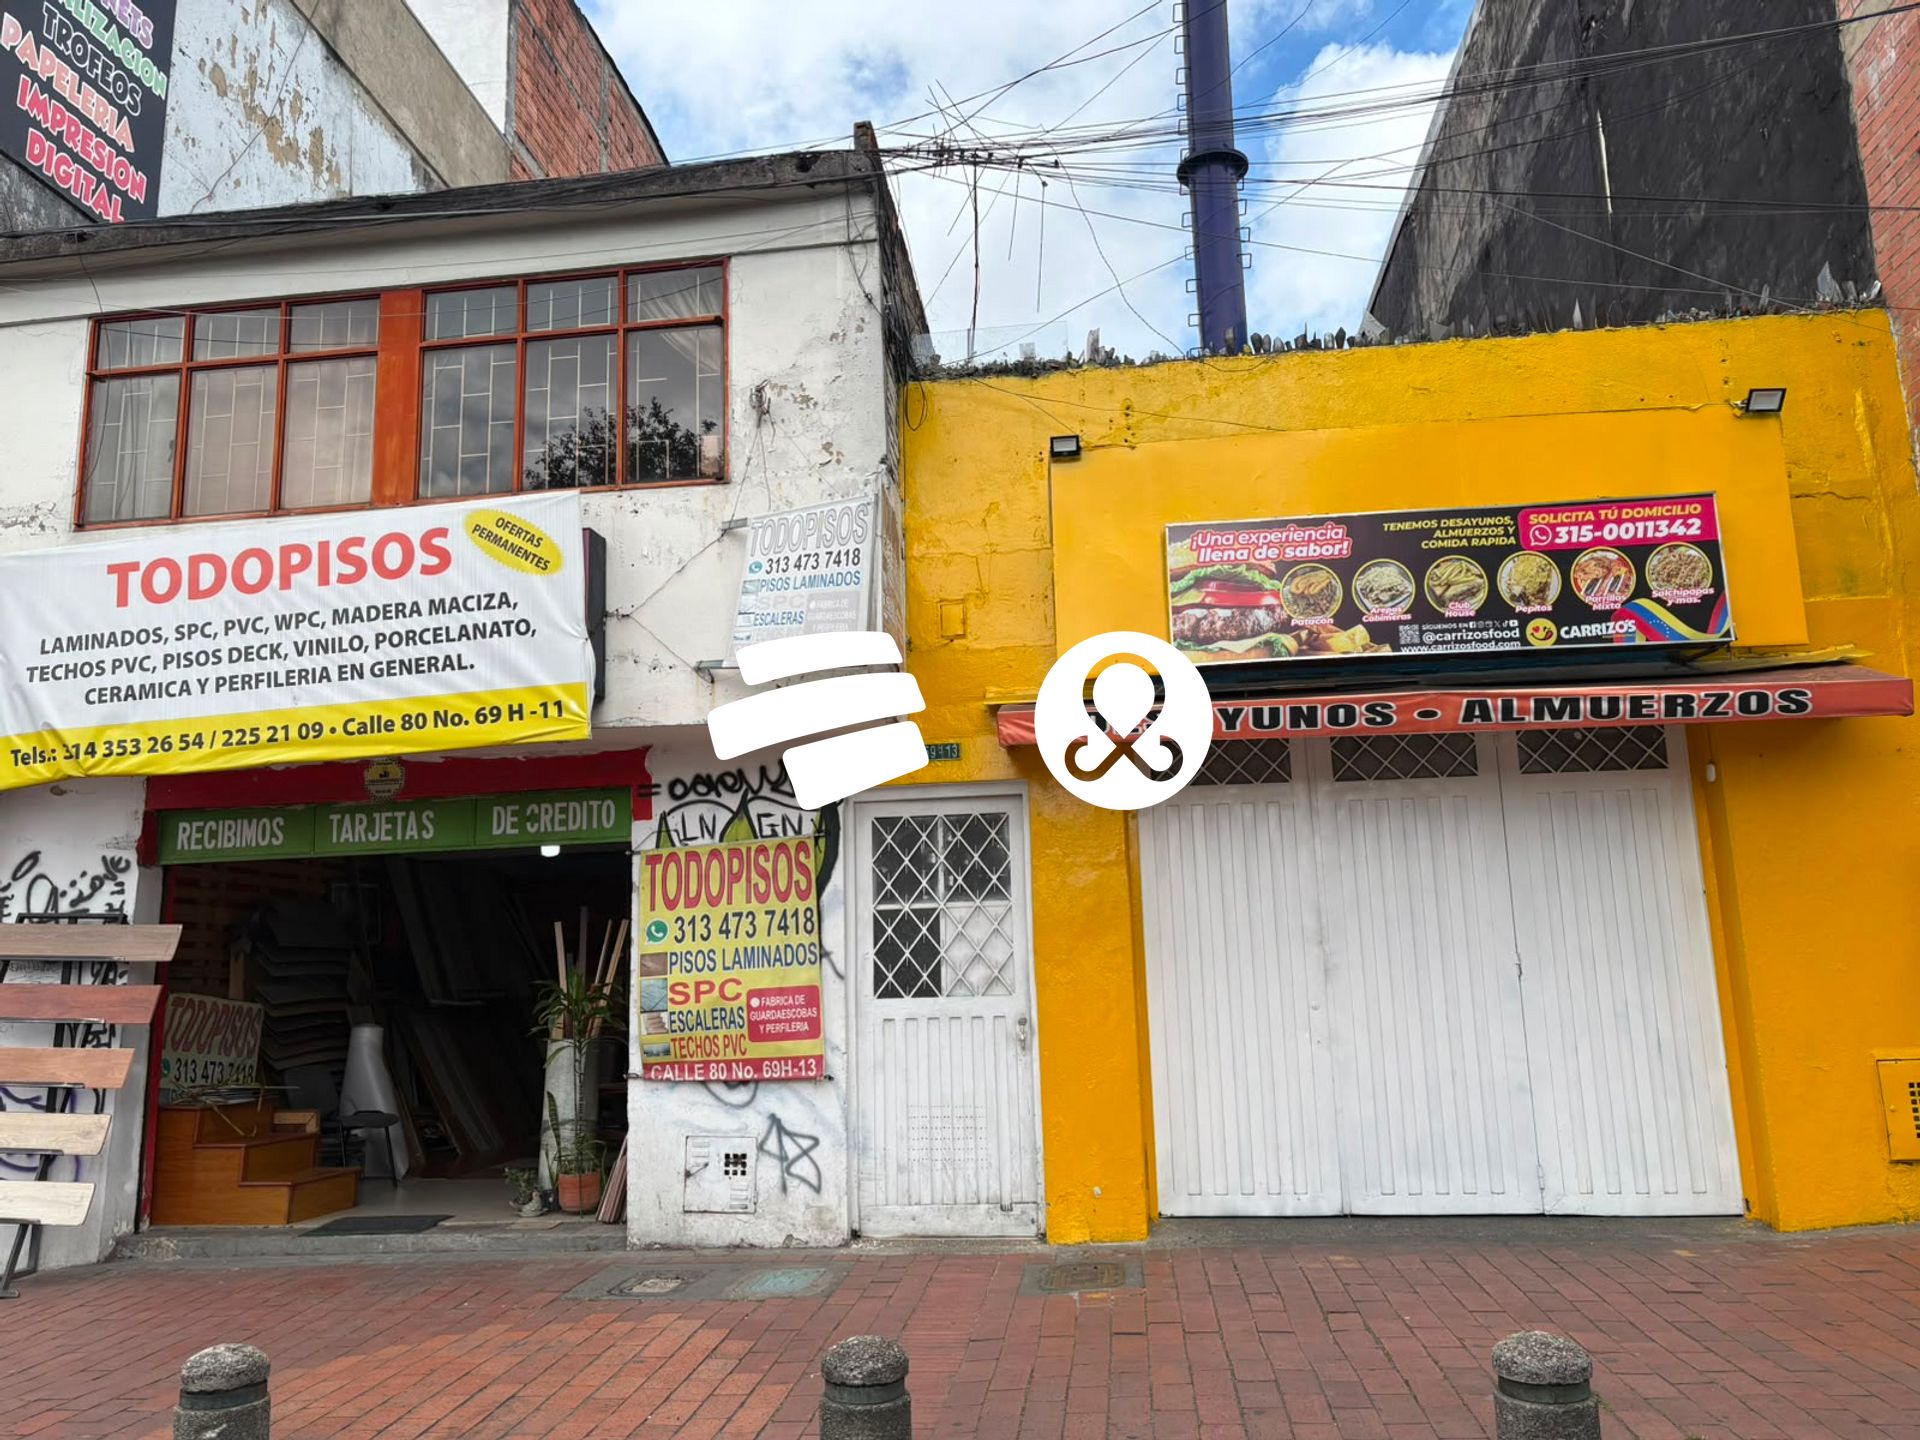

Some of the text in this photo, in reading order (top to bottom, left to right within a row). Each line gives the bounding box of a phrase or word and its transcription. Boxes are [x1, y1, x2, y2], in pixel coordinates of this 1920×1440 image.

[42, 2, 142, 116] TROFEOS
[0, 12, 135, 153] PAPELERIA
[17, 74, 147, 204] IMPRESION
[25, 128, 125, 223] DIGITAL
[1383, 516, 1514, 531] TENEMOS DESAYUNOS,
[1529, 504, 1702, 525] SOLICITA TÚ DOMICILIO
[495, 517, 543, 548] OFERTAS
[750, 502, 869, 557] TODOPISOS
[1191, 523, 1343, 550] ¡Una experiencia
[1421, 536, 1516, 549] COMIDA RAPIDA
[1433, 526, 1516, 539] ALMUERZOS Y
[1554, 518, 1702, 544] 315-0011342
[472, 524, 551, 571] PERMANENTES
[765, 547, 861, 575] 313 473 7418
[1200, 540, 1348, 562] llena de sabor!
[107, 526, 453, 609] TODOPISOS
[760, 570, 861, 593] PISOS LAMINADOS
[753, 610, 805, 627] ESCALERAS
[1445, 609, 1476, 617] House
[1449, 602, 1470, 610] Club
[1515, 605, 1553, 614] Pepitos
[40, 591, 519, 655] LAMINADOS, SPC, PVC, WPC, MADERA MACIZA,
[1422, 628, 1521, 644] @carrizosfood
[26, 618, 537, 683] TECHOS PVC, PISOS DECK, VINILO, PORCELANATO,
[84, 653, 476, 706] CERAMICA Y PERFILERIA EN GENERAL.
[1458, 688, 1813, 725] ALMUERZOS
[10, 747, 58, 767] Tels.:
[62, 741, 97, 761] 314
[102, 738, 141, 758] 353
[147, 735, 173, 753] 26
[178, 732, 204, 752] 54
[209, 730, 217, 750] /
[221, 727, 261, 749] 225
[266, 725, 290, 744] 21
[297, 721, 324, 741] 09
[342, 714, 396, 737] Calle
[400, 712, 427, 732] 80
[433, 708, 470, 729] No.
[474, 704, 503, 726] 69
[508, 703, 524, 722] H
[330, 810, 434, 843] TARJETAS
[492, 799, 616, 835] DE CREDITO
[177, 817, 284, 850] RECIBIMOS
[645, 840, 813, 912] TODOPISOS
[673, 906, 815, 944] 313 473 7418
[669, 942, 818, 974] PISOS LAMINADOS
[668, 978, 743, 1006] SPC
[761, 994, 806, 1006] FABRICA DE
[164, 996, 263, 1058] TODOPISOS
[669, 1006, 745, 1034] ESCALERAS
[750, 1008, 817, 1021] GUARDAESCOBAS
[759, 1022, 809, 1034] Y PERFILERIA
[671, 1033, 747, 1059] TECHOS PVC
[174, 1057, 197, 1082] 313
[200, 1060, 224, 1083] 473
[651, 1056, 817, 1081] CALLE 80 No. 69H-13
